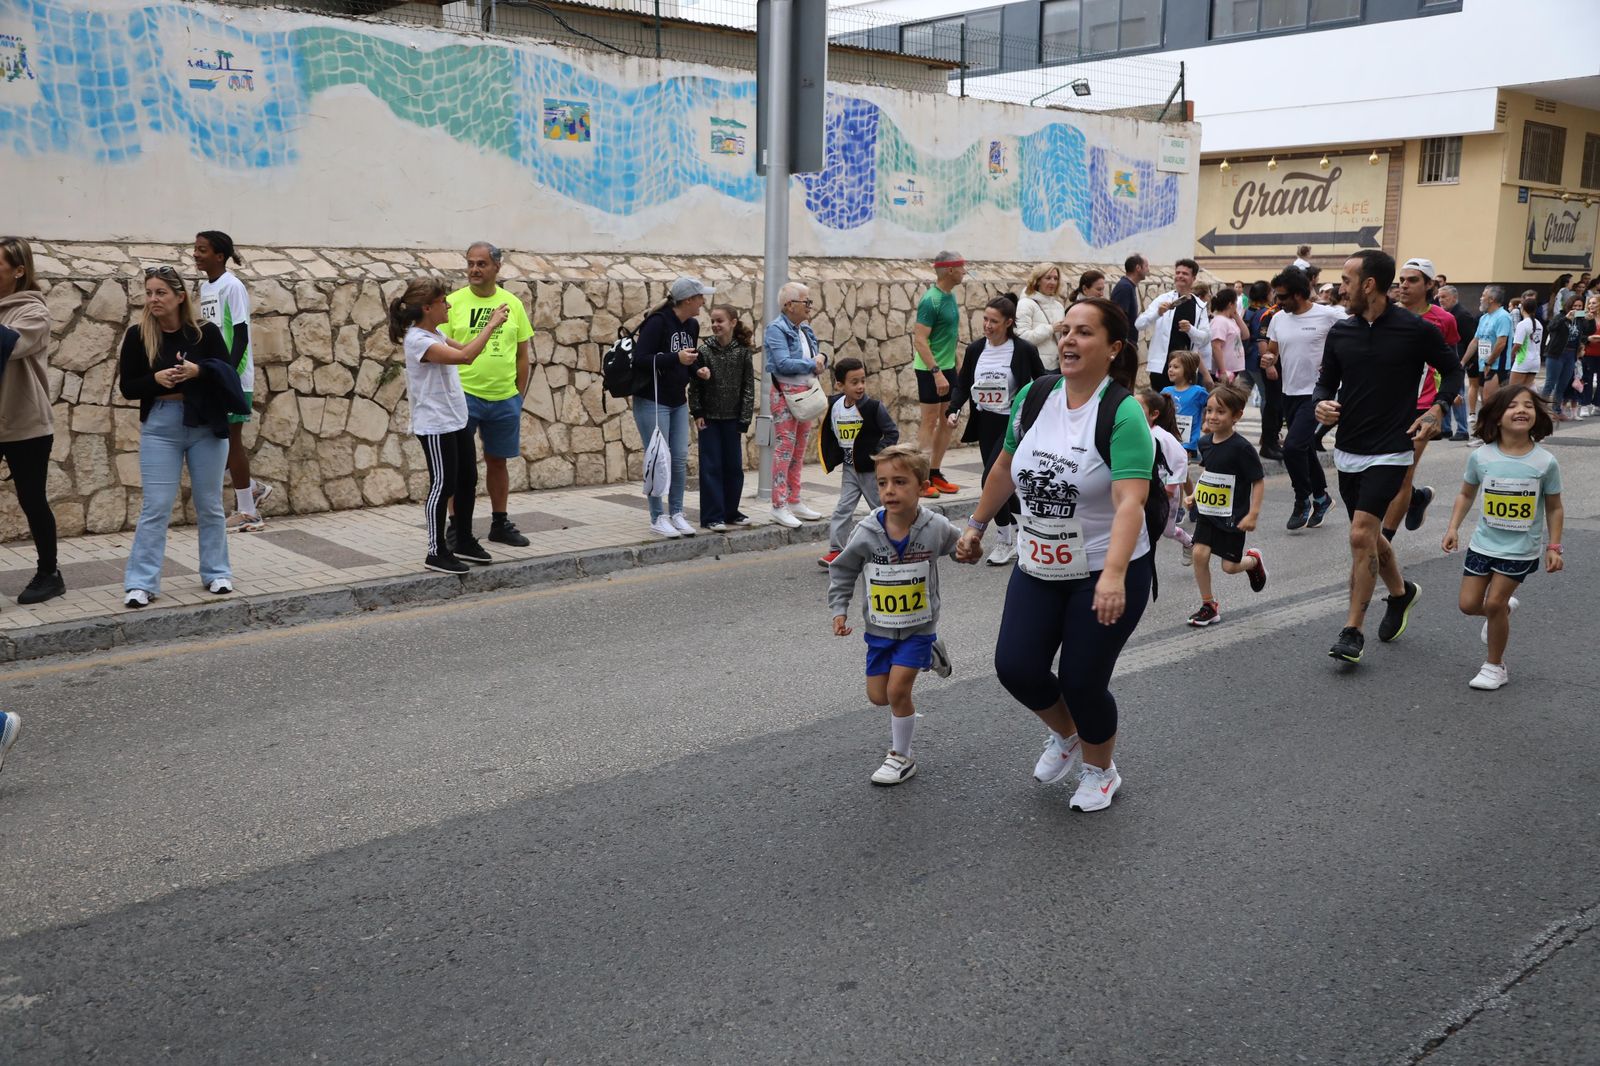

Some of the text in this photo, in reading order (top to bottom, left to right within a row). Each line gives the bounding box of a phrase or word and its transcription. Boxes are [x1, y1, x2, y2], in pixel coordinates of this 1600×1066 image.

[1221, 174, 1239, 187] LE
[1229, 166, 1342, 230] Grand
[1331, 200, 1369, 215] CAFÉ
[1542, 210, 1581, 252] Grand
[202, 306, 216, 319] 614
[469, 307, 483, 328] V
[978, 392, 1004, 403] 212
[1196, 490, 1227, 506] 1003
[1027, 501, 1071, 517] EL PALO
[1487, 500, 1532, 518] 1058
[1029, 540, 1073, 565] 256
[874, 591, 924, 613] 1012
